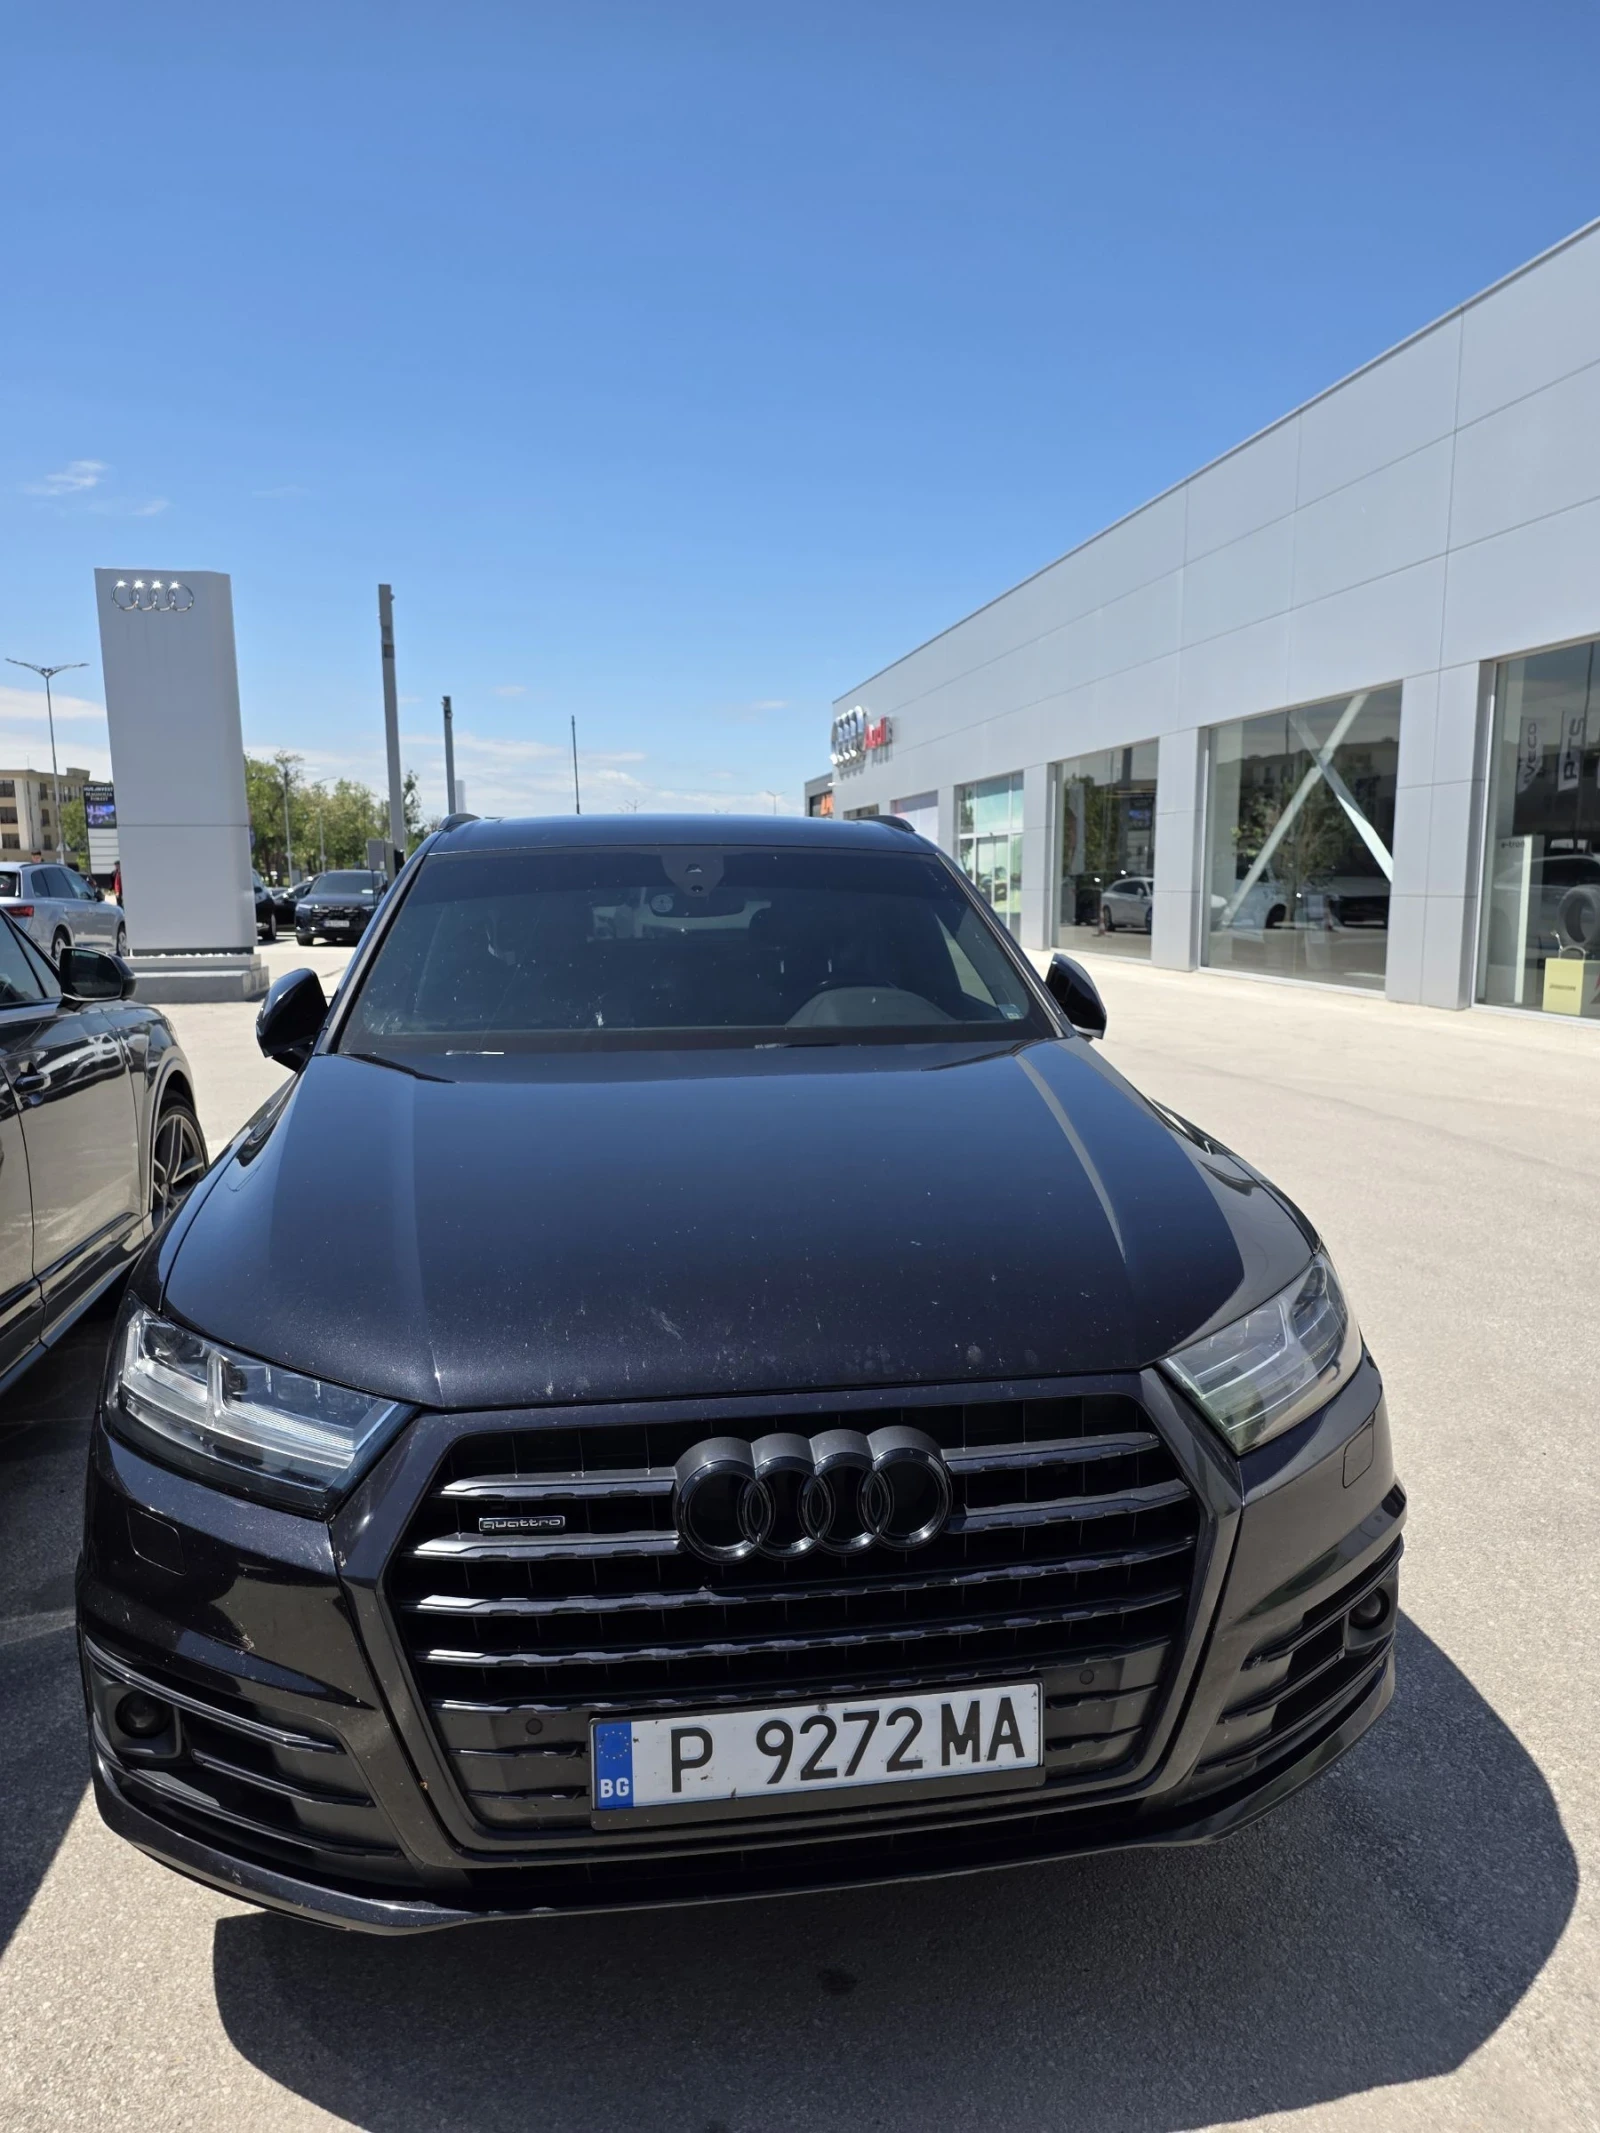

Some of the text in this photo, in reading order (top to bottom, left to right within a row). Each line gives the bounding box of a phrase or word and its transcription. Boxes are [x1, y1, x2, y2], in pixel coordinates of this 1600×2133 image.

[483, 1519, 560, 1529] quattro
[670, 1696, 1025, 1793] P 9272 MA
[600, 1776, 630, 1798] BG
